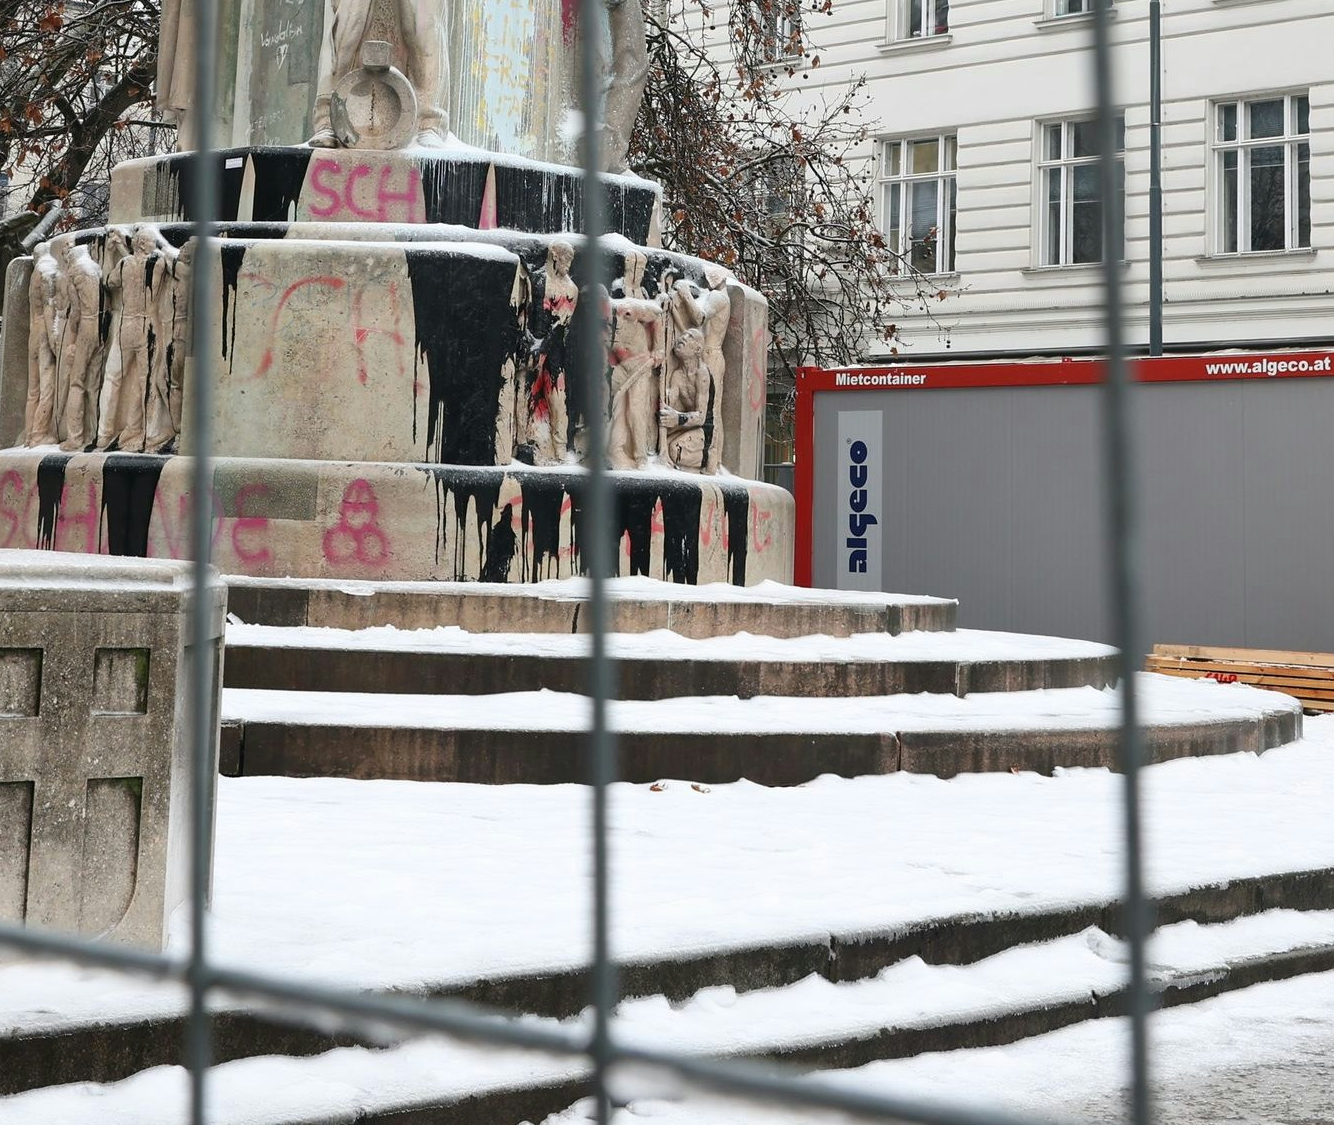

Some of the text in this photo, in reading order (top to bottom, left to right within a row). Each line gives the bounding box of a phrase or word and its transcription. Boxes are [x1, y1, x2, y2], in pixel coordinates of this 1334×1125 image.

[308, 158, 419, 222] SCH
[835, 373, 927, 386] Mietcontainer
[1206, 356, 1332, 375] www.algeco.at
[846, 440, 878, 573] algeco
